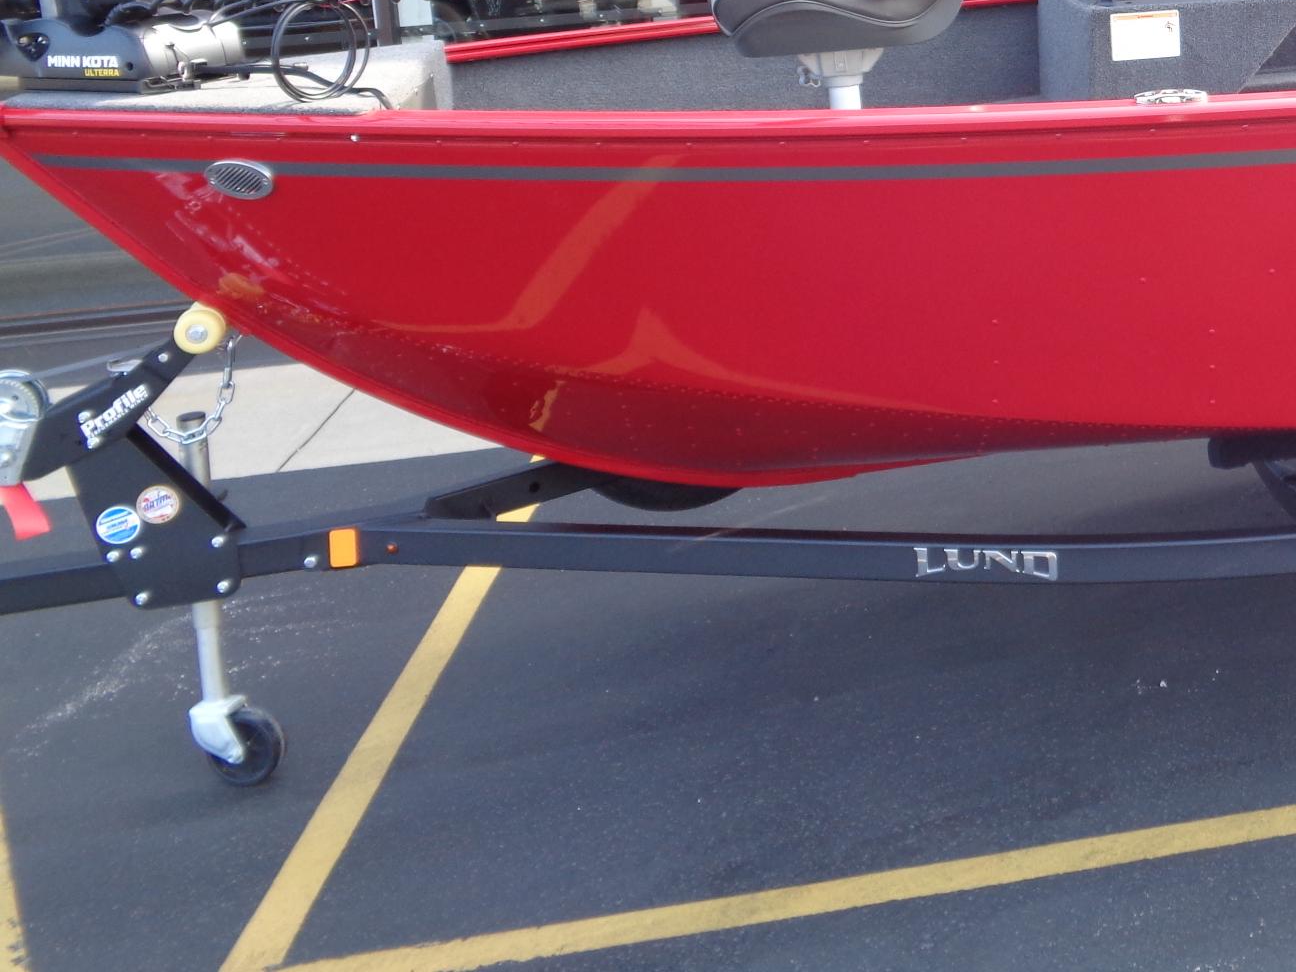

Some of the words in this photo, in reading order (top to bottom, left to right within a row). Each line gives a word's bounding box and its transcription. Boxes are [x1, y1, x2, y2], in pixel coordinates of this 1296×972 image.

[47, 55, 80, 68] MINN
[82, 55, 119, 68] KOTA
[84, 68, 120, 77] ULTERRA
[80, 383, 146, 439] Profile
[913, 547, 1058, 581] LUND
